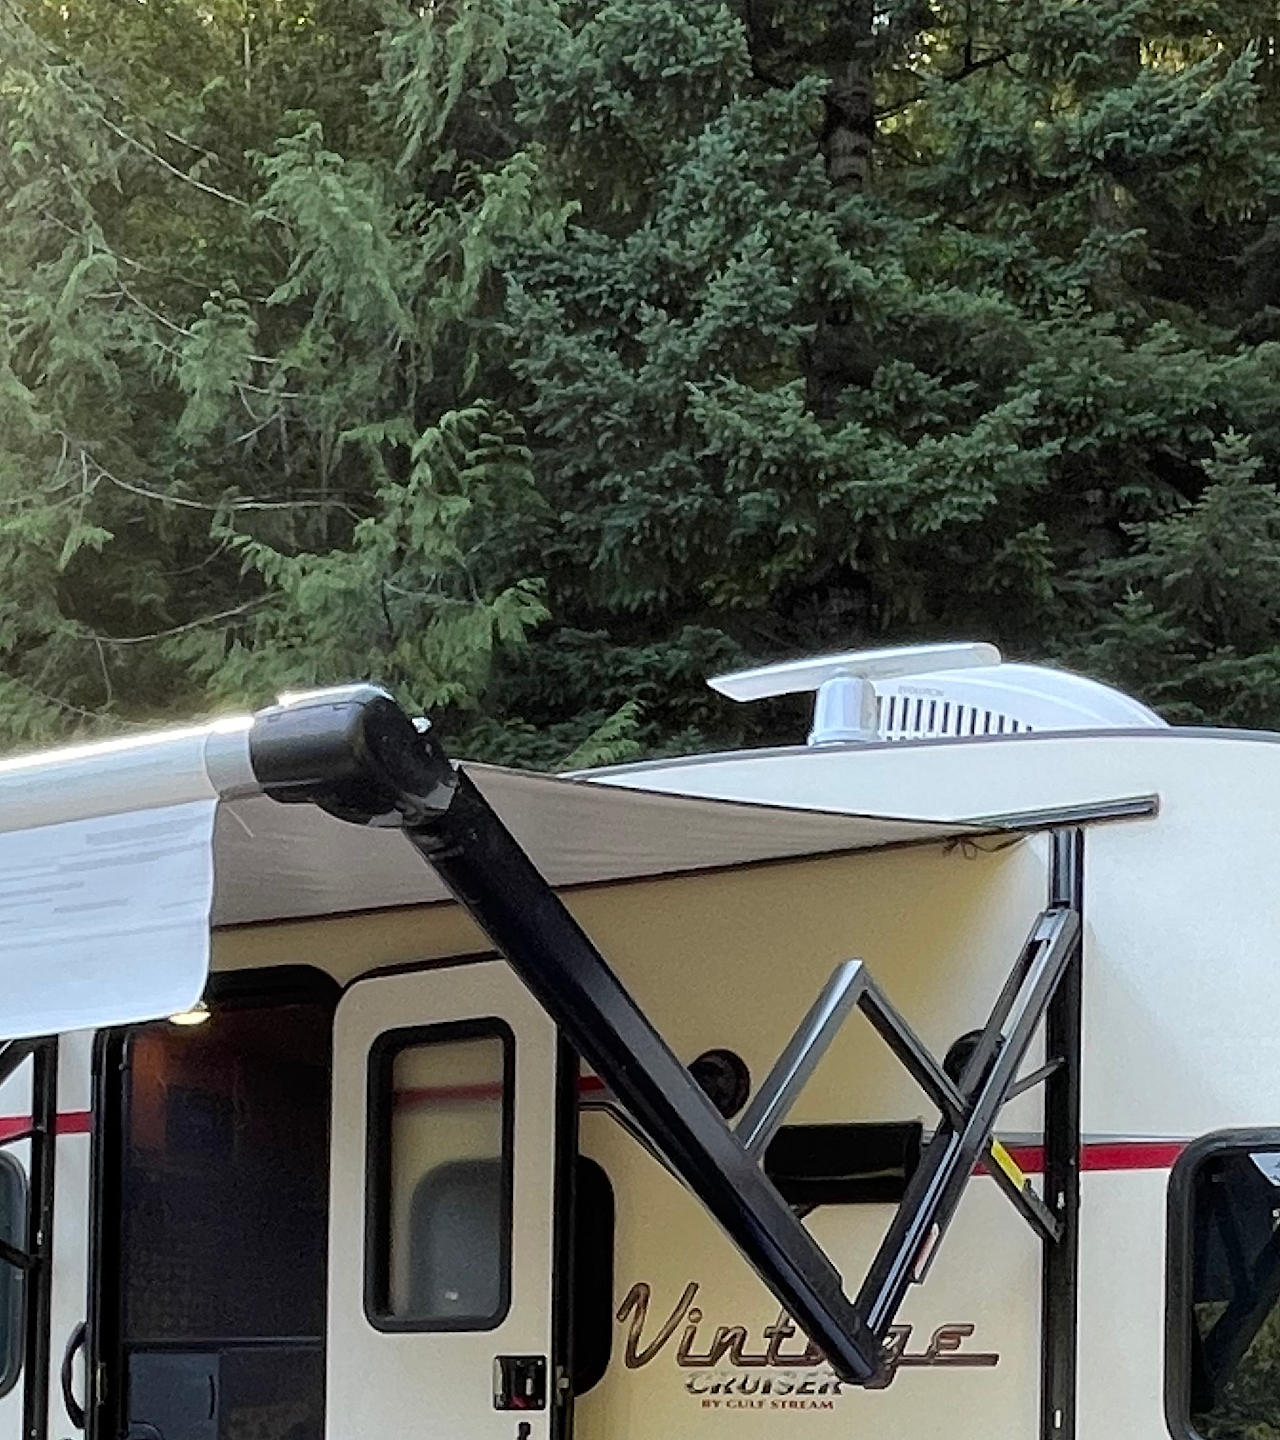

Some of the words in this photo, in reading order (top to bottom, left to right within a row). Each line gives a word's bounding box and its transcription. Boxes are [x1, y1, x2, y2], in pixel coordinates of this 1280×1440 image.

[616, 1282, 999, 1389] Vintge
[686, 1371, 842, 1395] CRUISER
[701, 1399, 722, 1410] BY
[726, 1399, 764, 1410] GULF
[770, 1399, 834, 1410] STREAM
